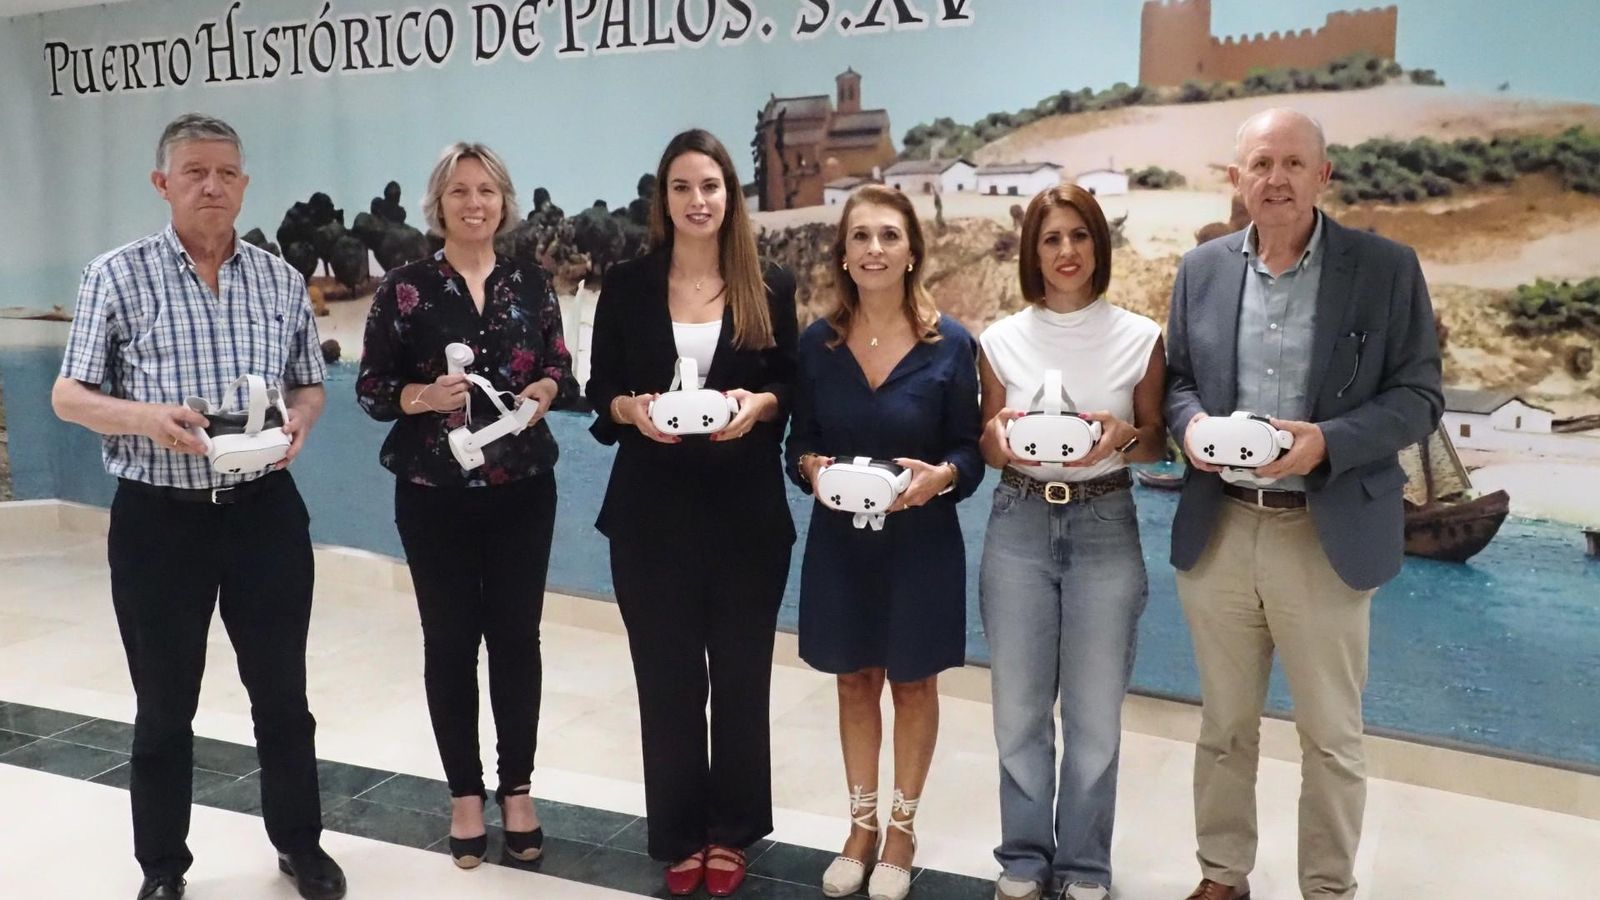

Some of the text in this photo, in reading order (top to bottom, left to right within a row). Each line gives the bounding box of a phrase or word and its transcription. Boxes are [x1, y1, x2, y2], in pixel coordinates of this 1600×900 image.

[43, 37, 192, 97] PUERTO
[195, 1, 454, 83] HISTÓRICO
[471, 1, 541, 60] DE
